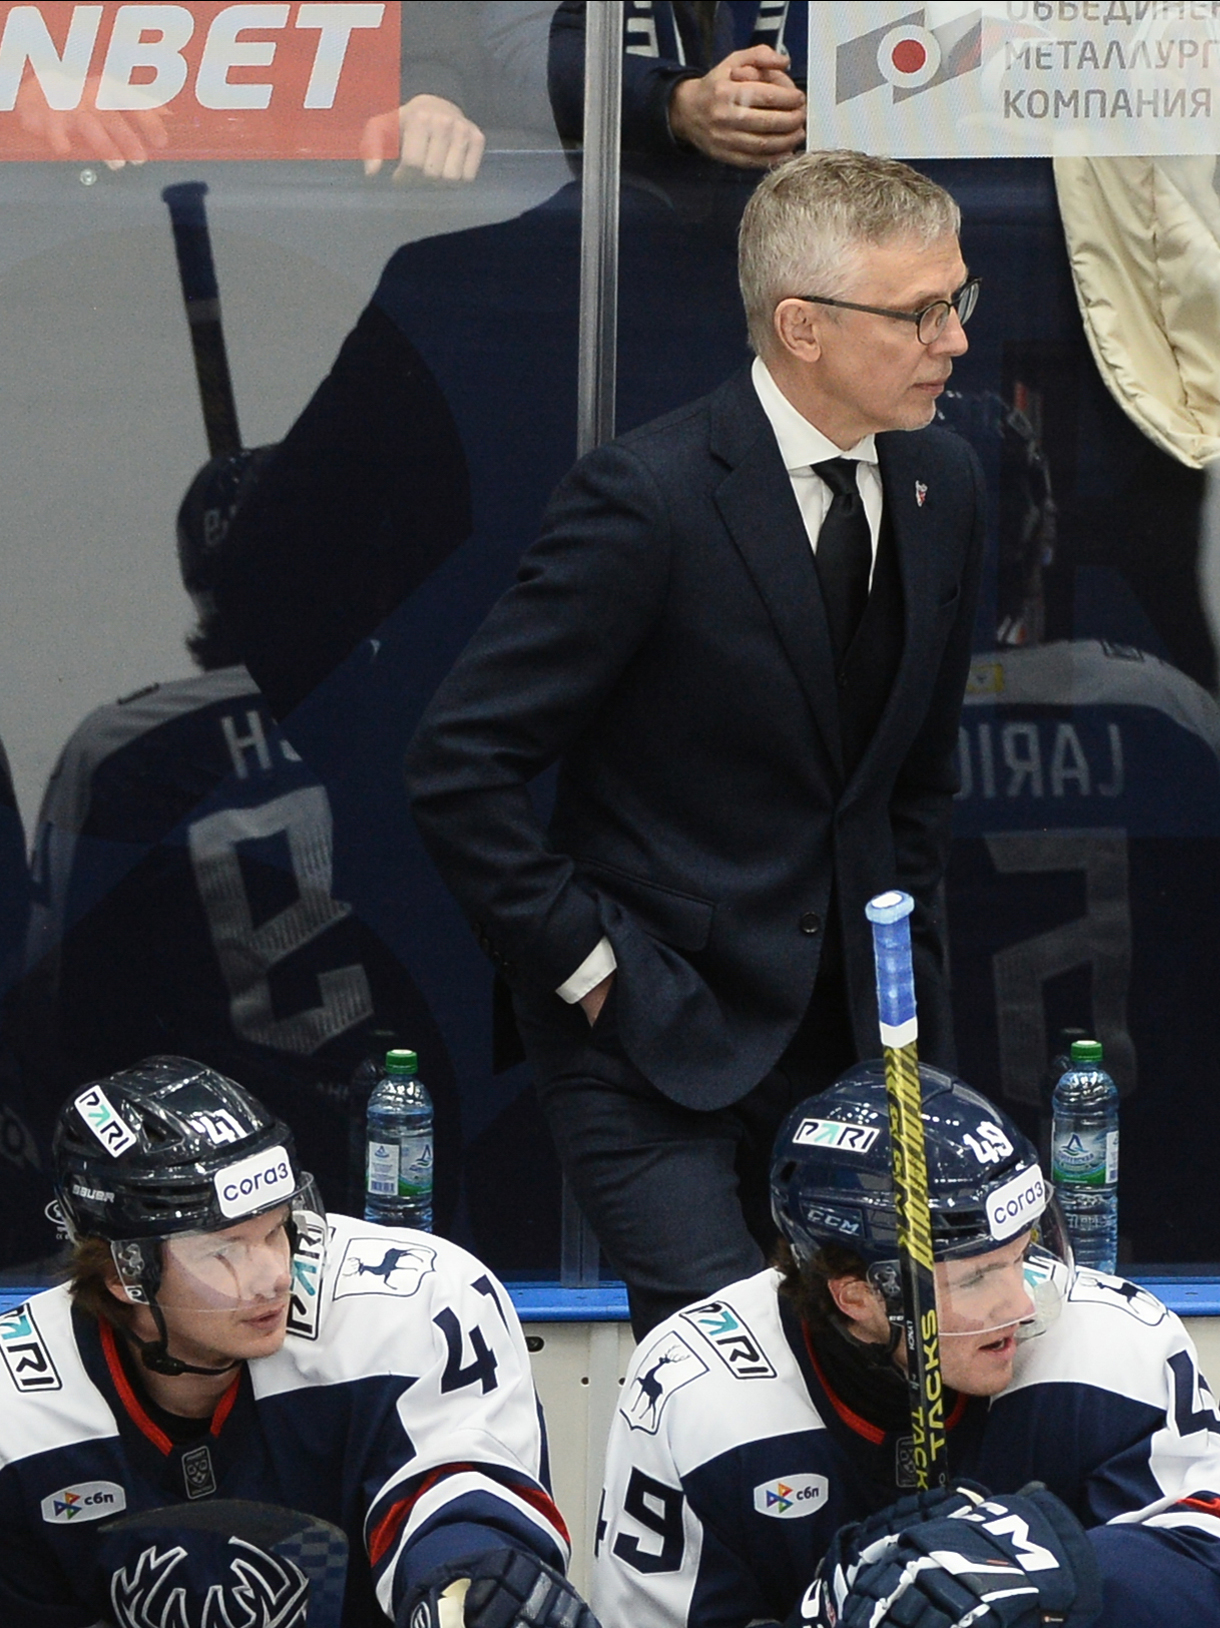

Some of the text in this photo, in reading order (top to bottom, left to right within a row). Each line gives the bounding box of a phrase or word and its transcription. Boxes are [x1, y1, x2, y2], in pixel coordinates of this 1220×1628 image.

[1002, 88, 1212, 119] КОМПАНИЯ
[78, 1090, 131, 1153] PARI
[800, 1121, 876, 1150] PARI
[962, 1121, 1014, 1164] 49
[223, 1162, 289, 1202] согаз
[806, 1209, 860, 1236] CCM
[993, 1181, 1044, 1225] согаз
[684, 1303, 769, 1373] PARI
[921, 1309, 946, 1462] TACKS
[911, 1406, 929, 1492] TACK
[83, 1491, 114, 1506] сбп
[796, 1485, 820, 1501] сбп
